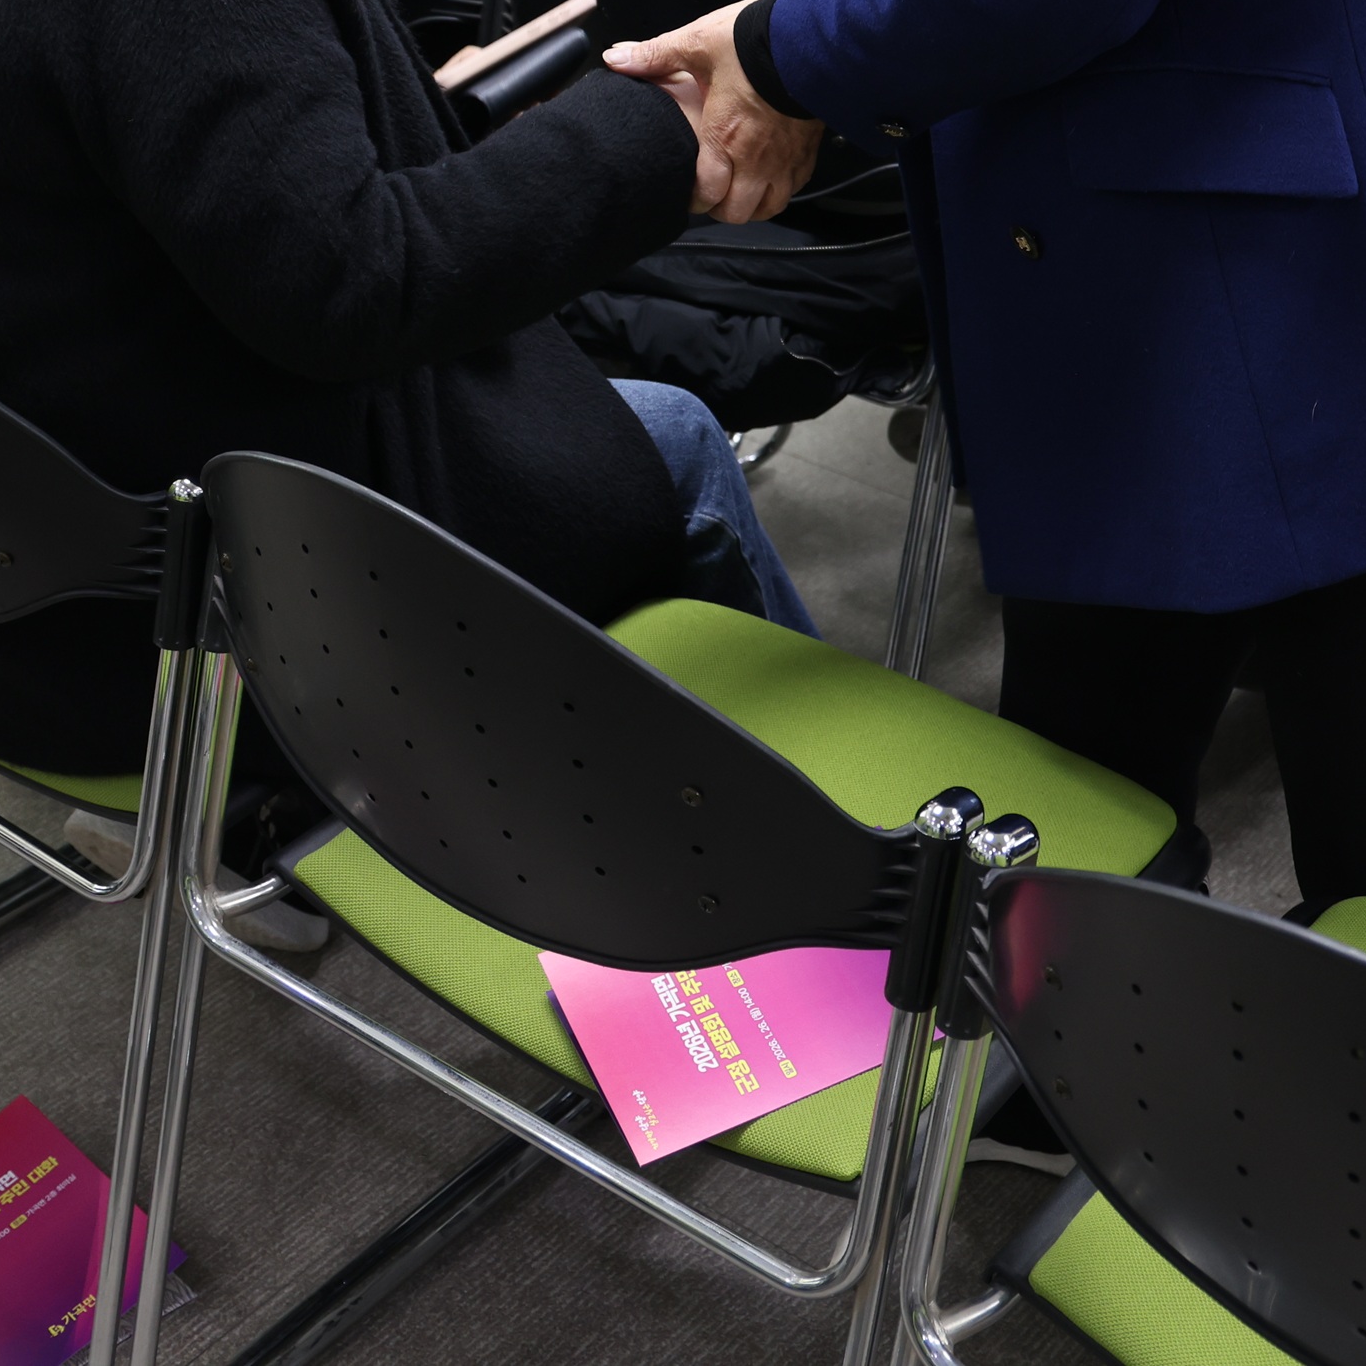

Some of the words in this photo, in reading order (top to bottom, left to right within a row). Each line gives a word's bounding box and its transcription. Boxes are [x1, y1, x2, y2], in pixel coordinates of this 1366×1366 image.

[650, 972, 692, 1023] 가곡면
[689, 993, 716, 1015] 및
[737, 987, 755, 1010] 14:00
[675, 1019, 720, 1073] 2026년
[699, 1011, 741, 1060] 설명회
[768, 1037, 787, 1061] 2026.
[725, 1059, 761, 1096] 군정
[26, 1155, 60, 1185] 대화
[61, 1294, 97, 1326] 가곡면
